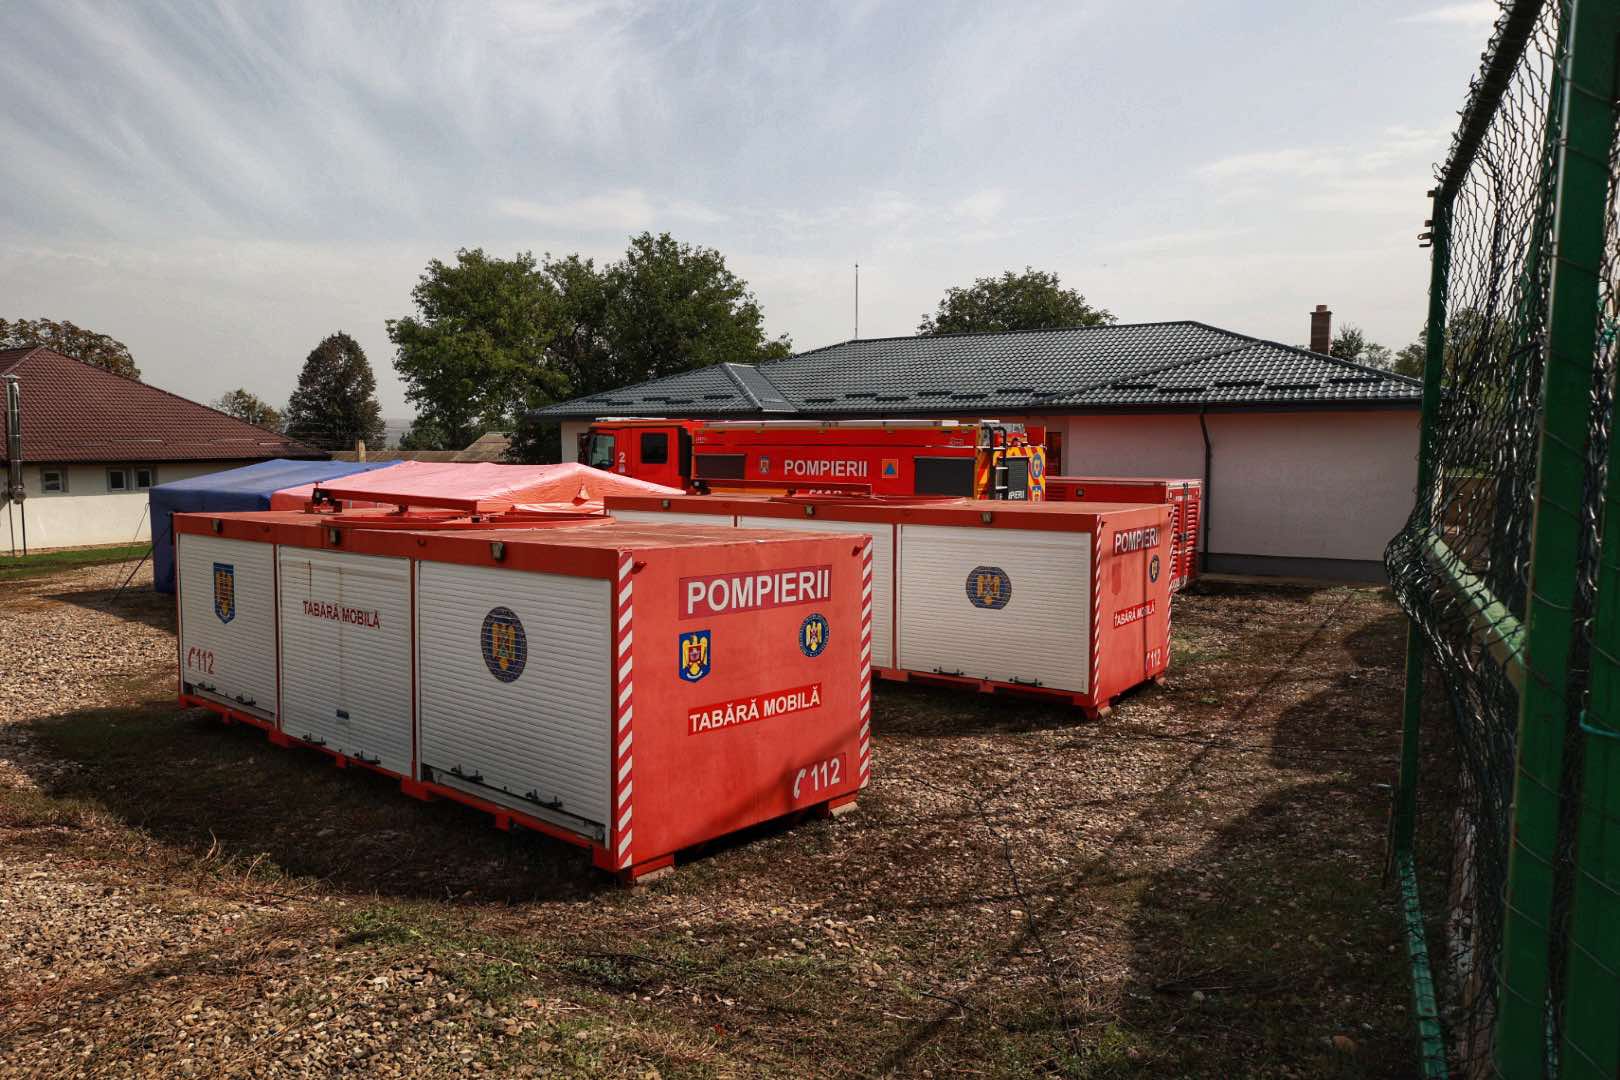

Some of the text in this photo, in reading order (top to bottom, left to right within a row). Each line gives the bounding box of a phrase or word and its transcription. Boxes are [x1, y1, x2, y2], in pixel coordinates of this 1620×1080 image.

[618, 452, 626, 463] 2
[784, 460, 868, 477] POMPIERII
[687, 569, 829, 614] POMPIERII
[196, 648, 214, 675] 112
[689, 686, 821, 732] TABĂRĂ MOBILĂ
[811, 758, 840, 791] 112
